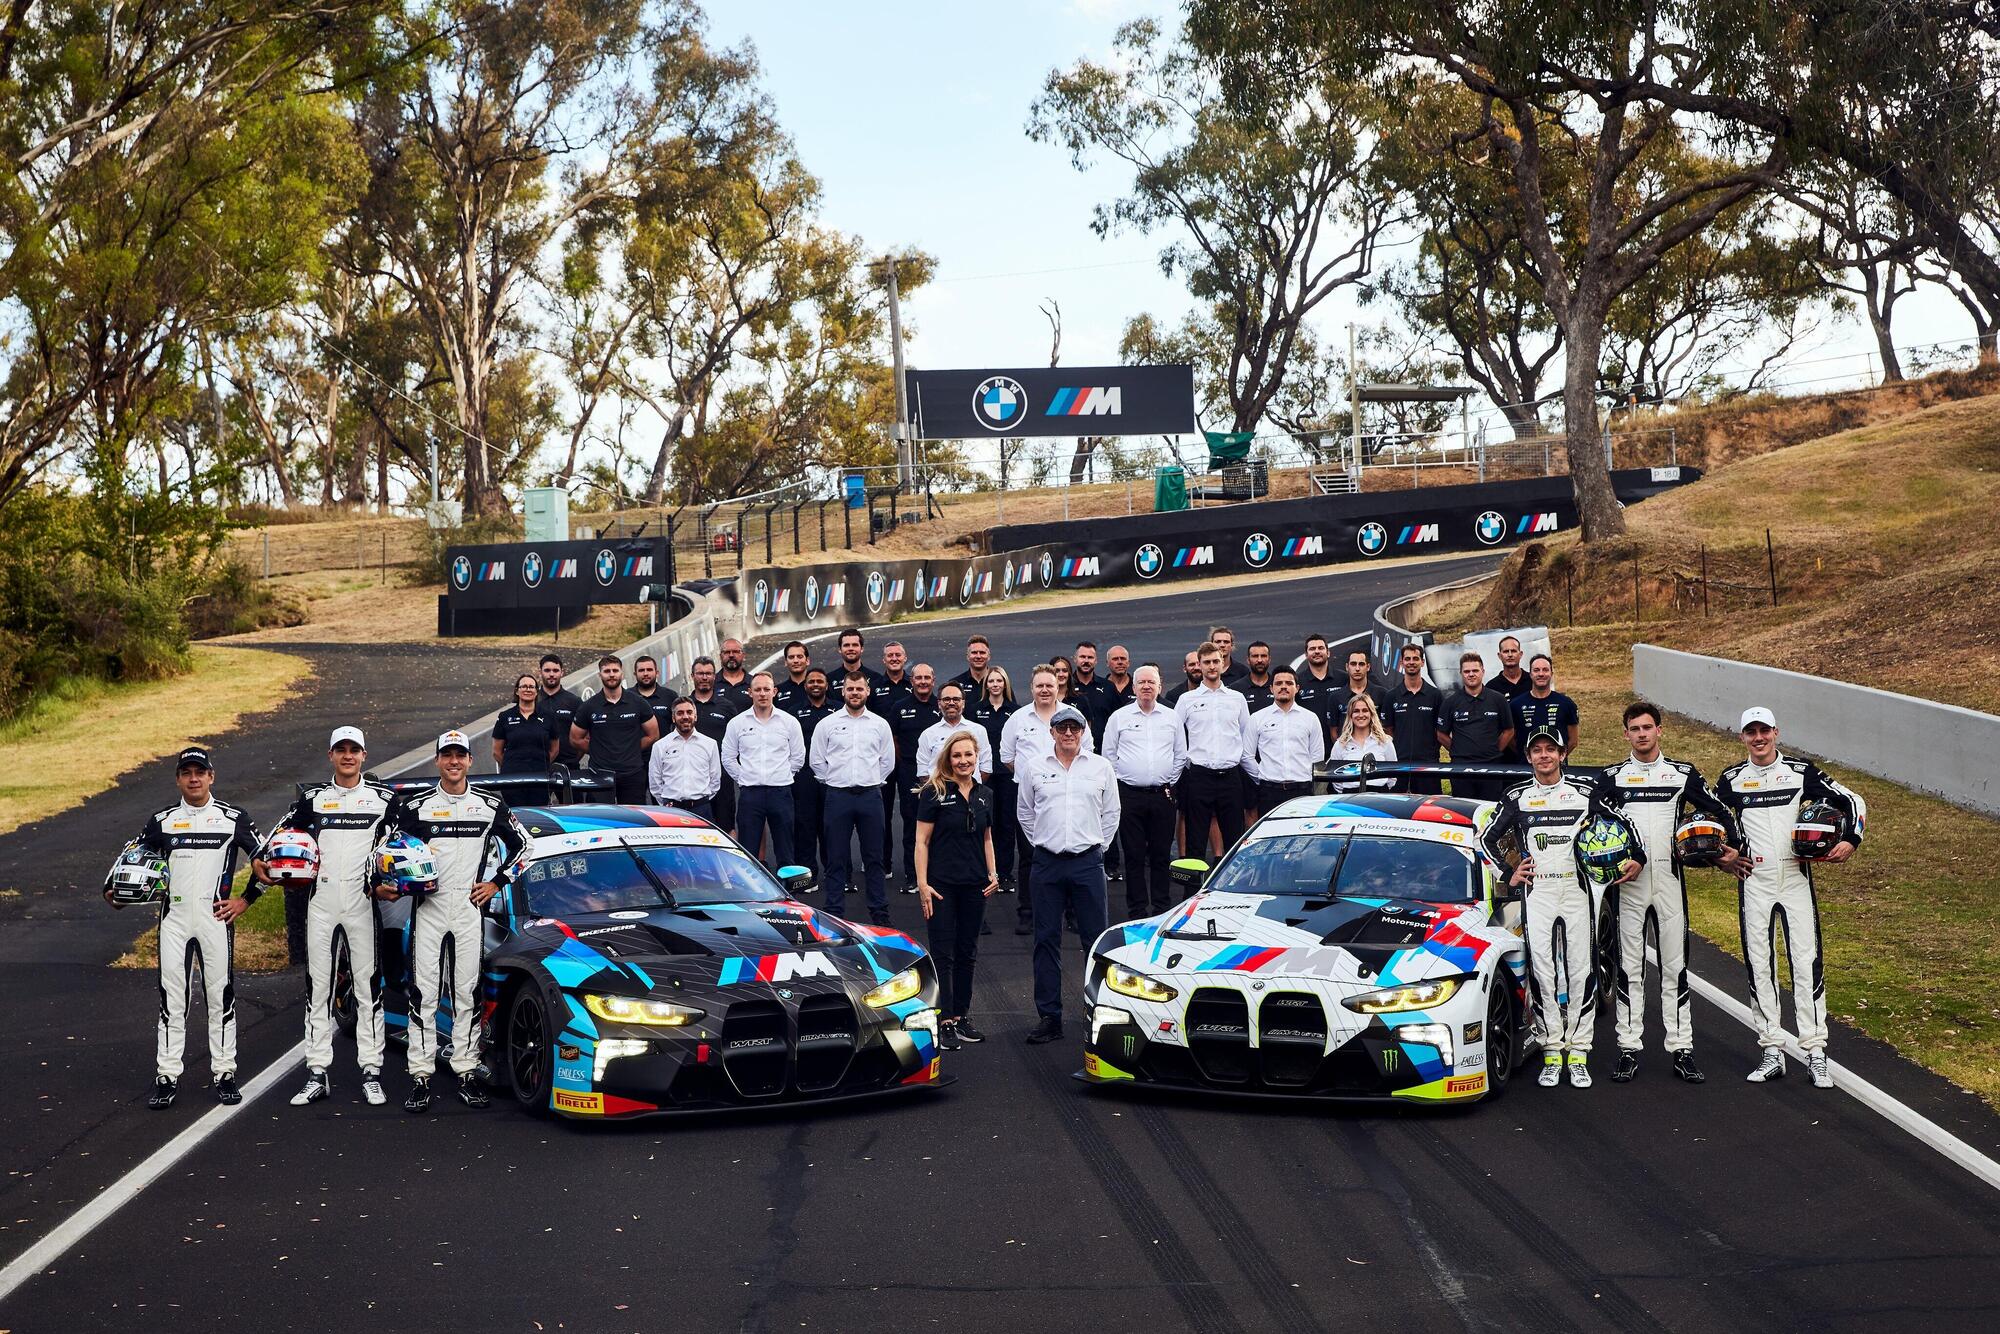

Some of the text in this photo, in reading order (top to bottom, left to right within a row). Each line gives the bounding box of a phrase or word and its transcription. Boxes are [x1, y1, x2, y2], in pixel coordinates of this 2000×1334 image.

[1078, 386, 1121, 415] M
[1533, 512, 1557, 532] M
[1415, 523, 1439, 543] M
[1299, 535, 1323, 556] M
[1190, 545, 1214, 566] M
[489, 561, 505, 580] M
[561, 558, 577, 578] M
[635, 556, 653, 576] M
[1076, 556, 1100, 576] M
[1764, 794, 1791, 802] Motorsport
[1356, 823, 1427, 834] Motorsport
[697, 834, 721, 844] 32
[1439, 831, 1464, 842] 46
[762, 917, 809, 926] Motorsport
[1422, 911, 1441, 919] M
[1381, 916, 1434, 929] Motorsport
[577, 924, 636, 938] SKECHERS
[771, 952, 842, 982] M
[1252, 947, 1341, 977] M
[1196, 1024, 1243, 1032] WRT
[730, 1038, 773, 1048] WRT
[1461, 1053, 1484, 1066] ENDLESS
[557, 1066, 586, 1079] ENDLESS
[1447, 1076, 1484, 1092] PIRELLI
[557, 1092, 598, 1109] PIRELLI
